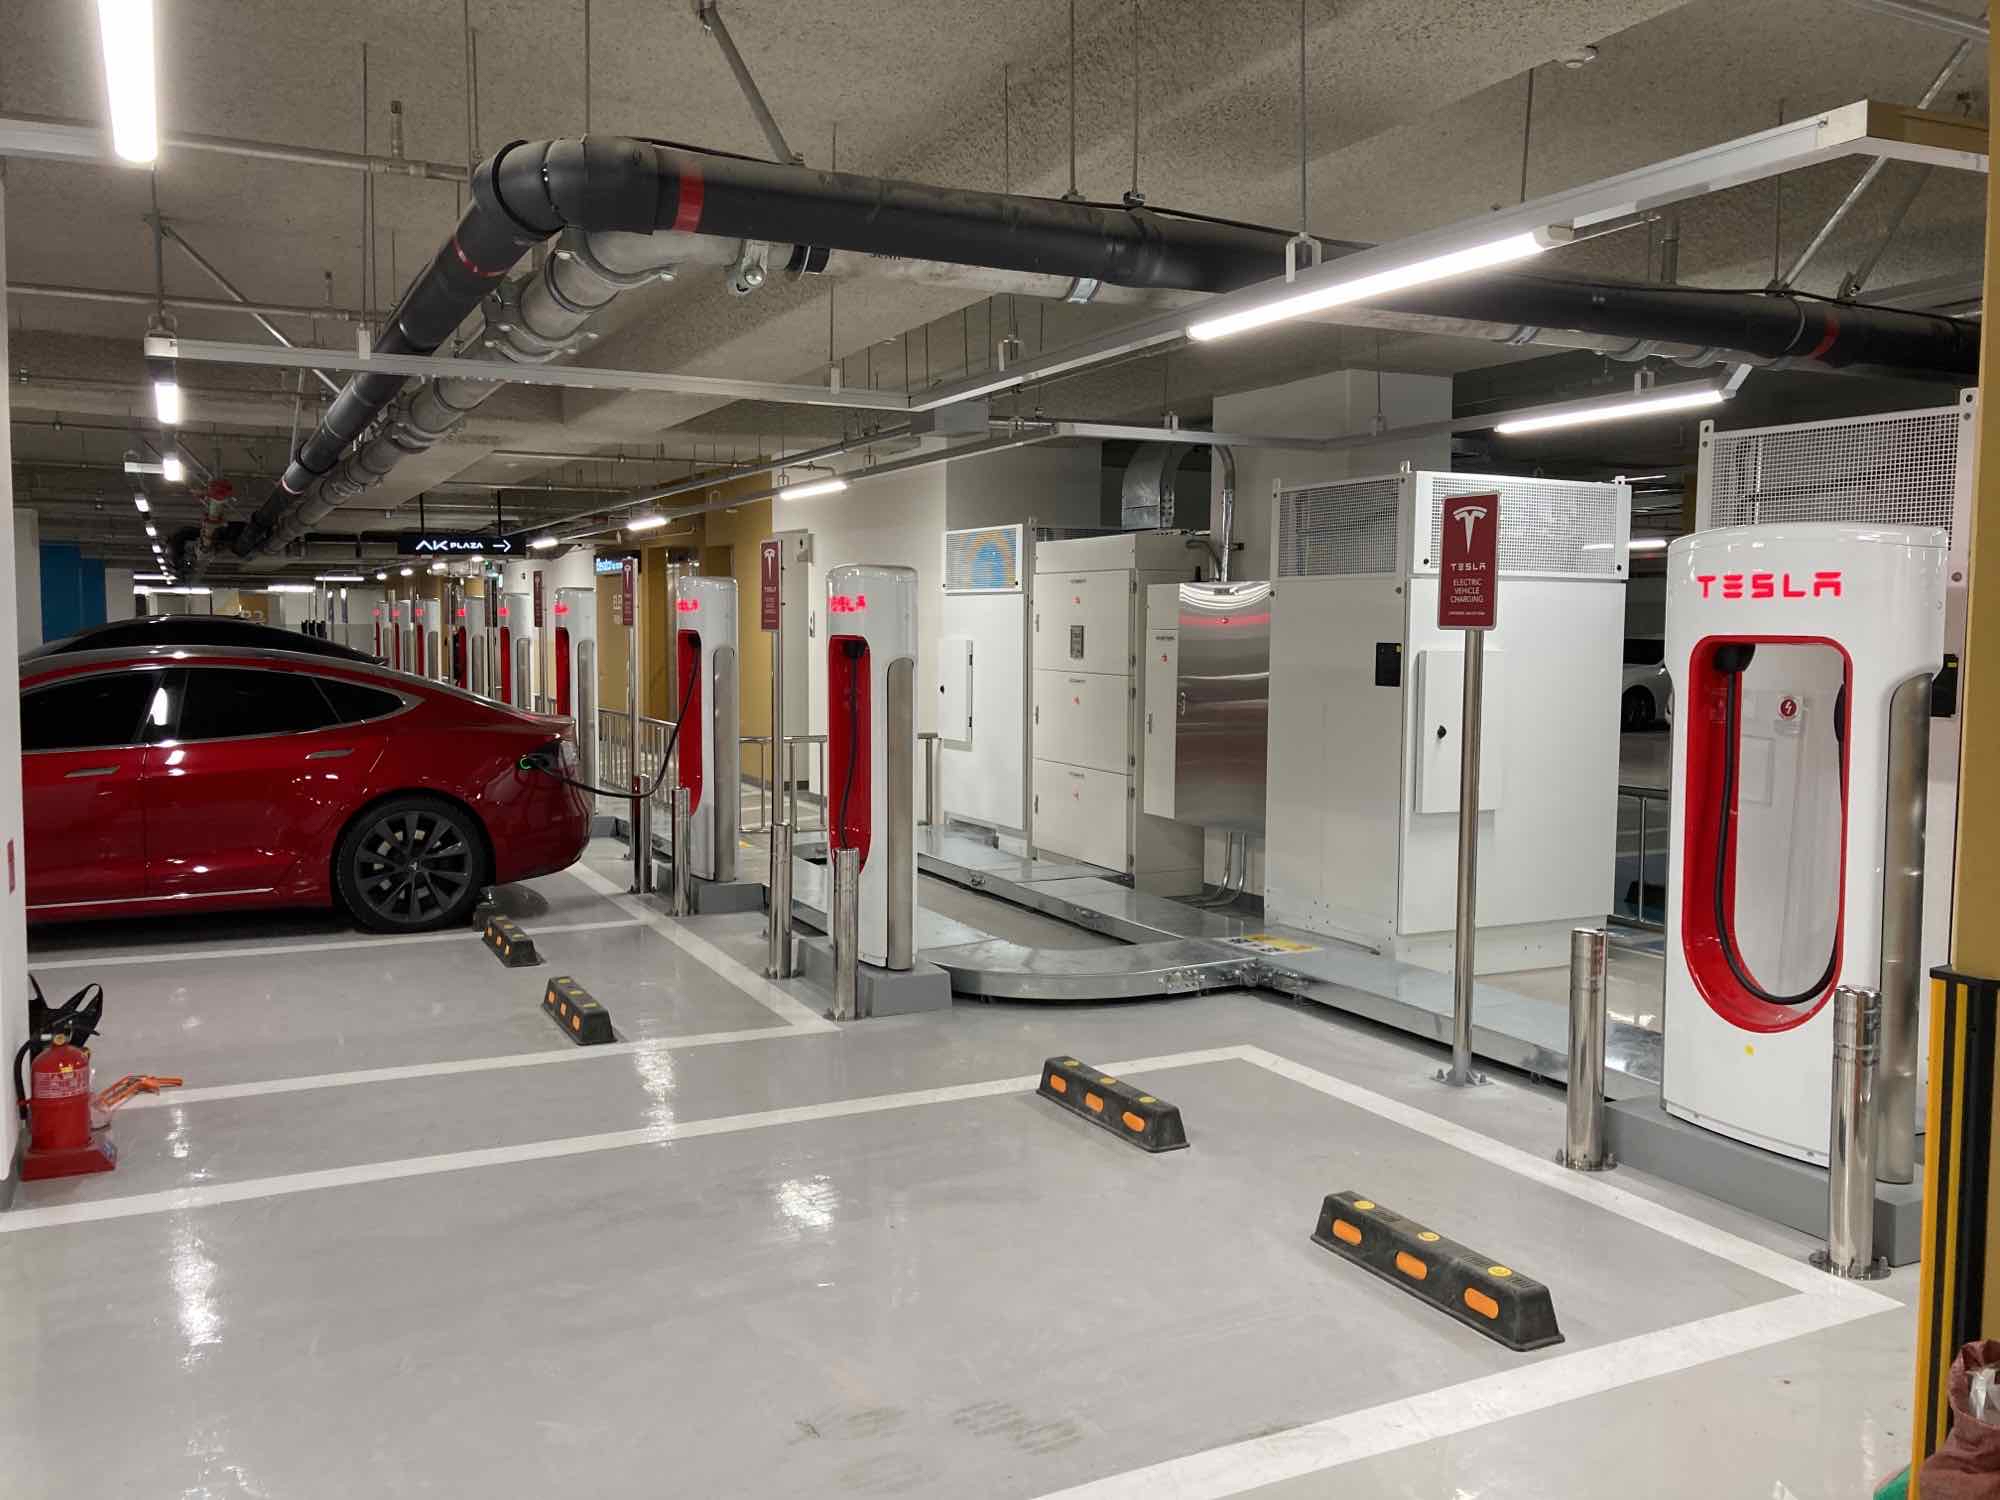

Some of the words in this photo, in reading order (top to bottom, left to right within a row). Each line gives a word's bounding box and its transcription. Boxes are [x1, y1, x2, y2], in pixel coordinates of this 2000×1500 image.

[415, 540, 449, 551] AK
[1450, 562, 1487, 571] TESLA
[1453, 578, 1482, 586] ELECTRIC
[1696, 571, 1843, 599] TESLA
[1450, 595, 1484, 603] CHARGING
